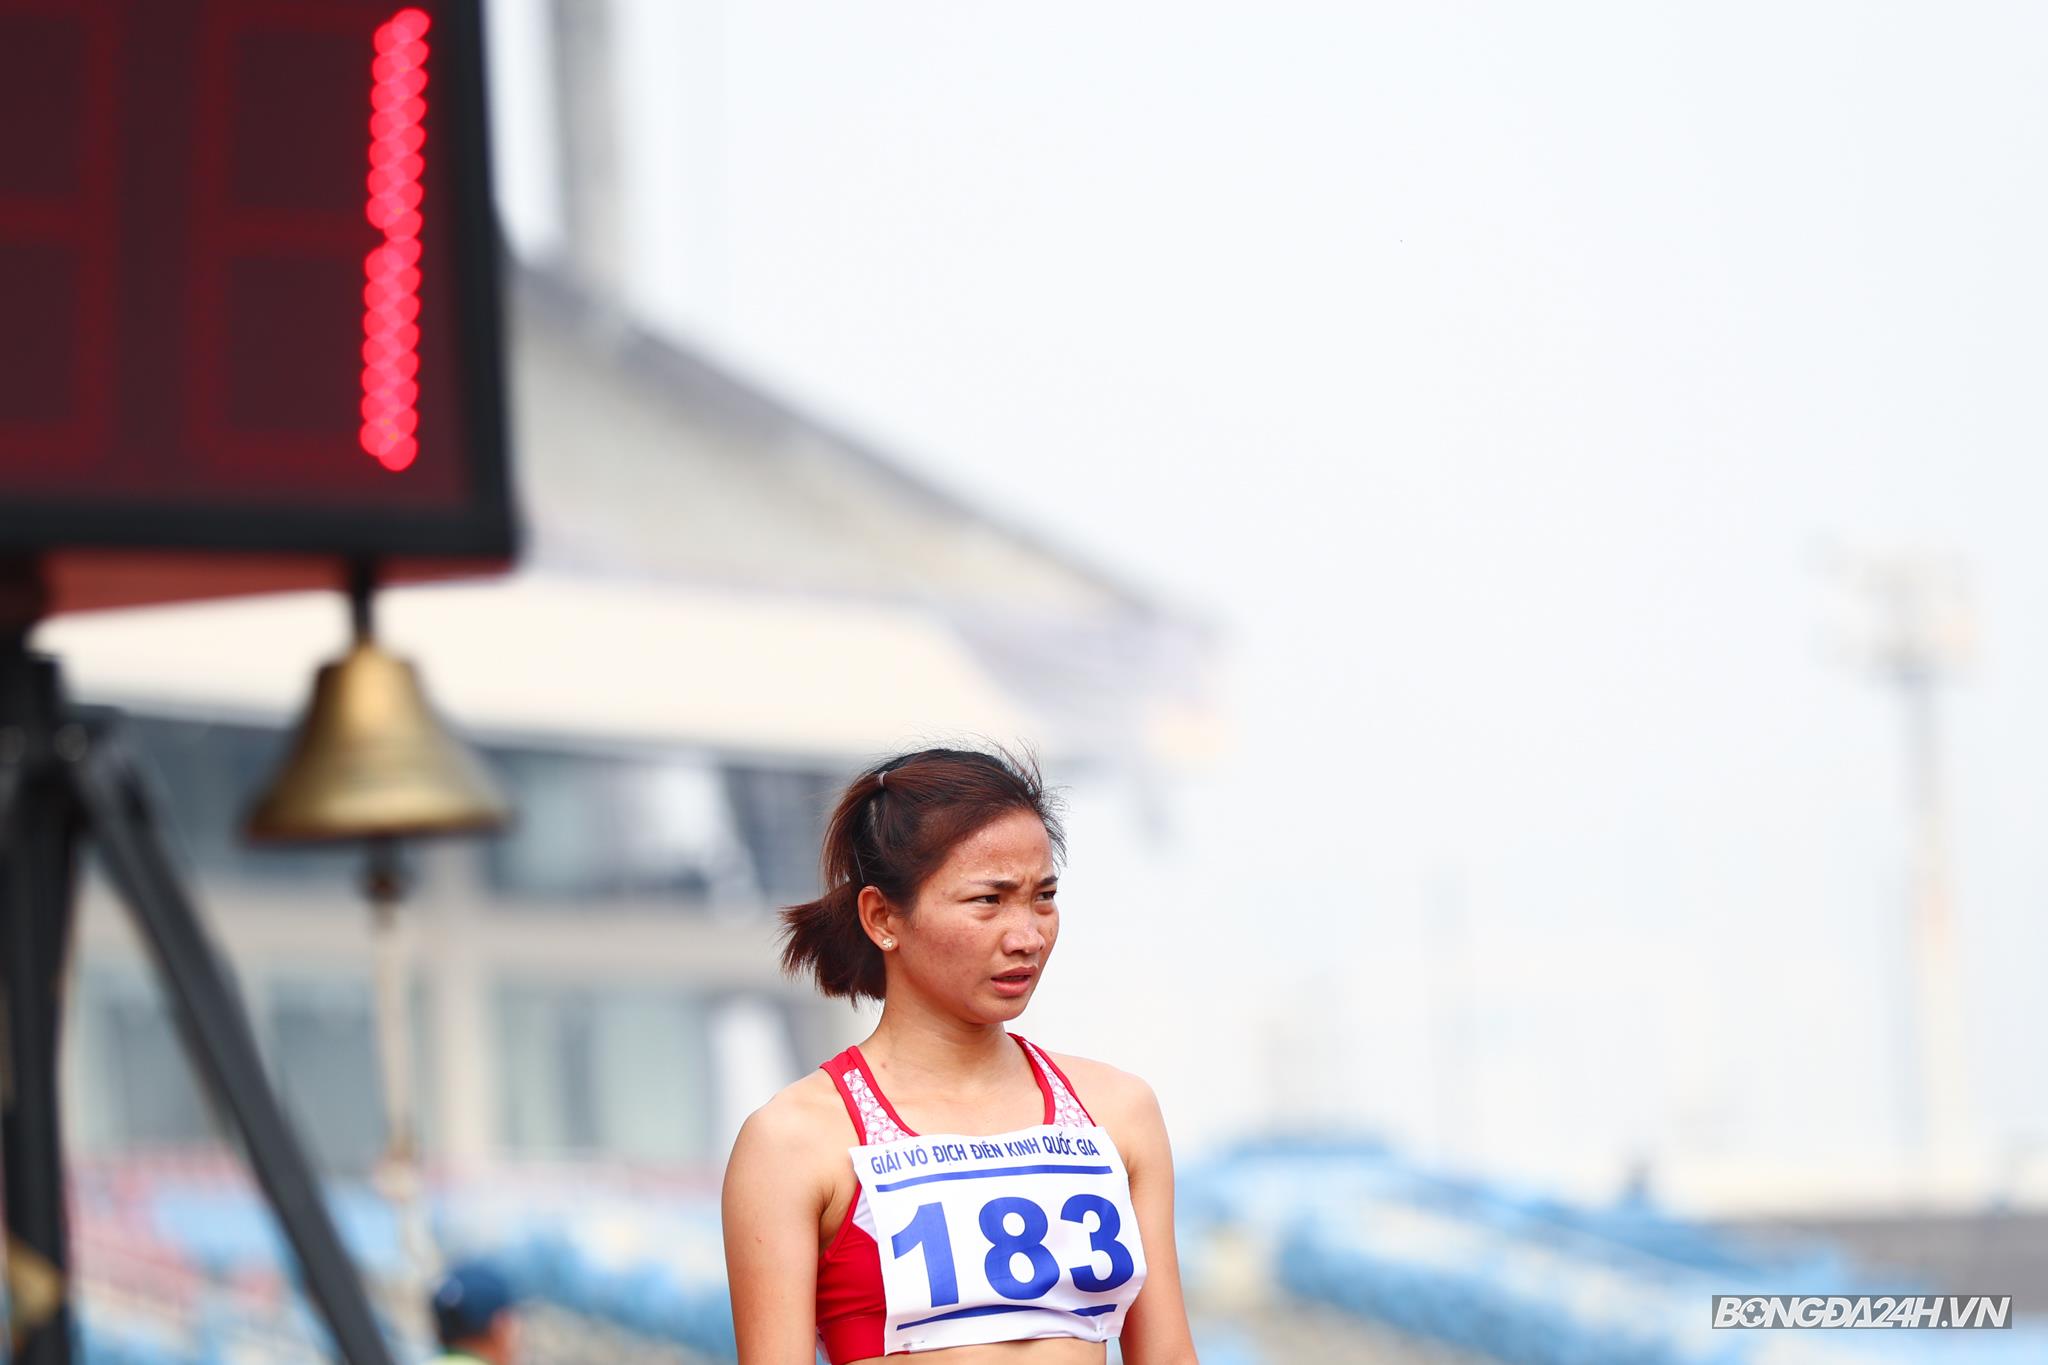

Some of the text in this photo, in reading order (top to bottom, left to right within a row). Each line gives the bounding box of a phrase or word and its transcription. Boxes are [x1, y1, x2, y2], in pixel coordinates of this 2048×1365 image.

[904, 1144, 928, 1166] VÔ
[1005, 1137, 1041, 1158] KINH
[1042, 1131, 1077, 1156] QUỐC
[1076, 1137, 1100, 1157] GIA
[891, 1193, 1134, 1308] 183
